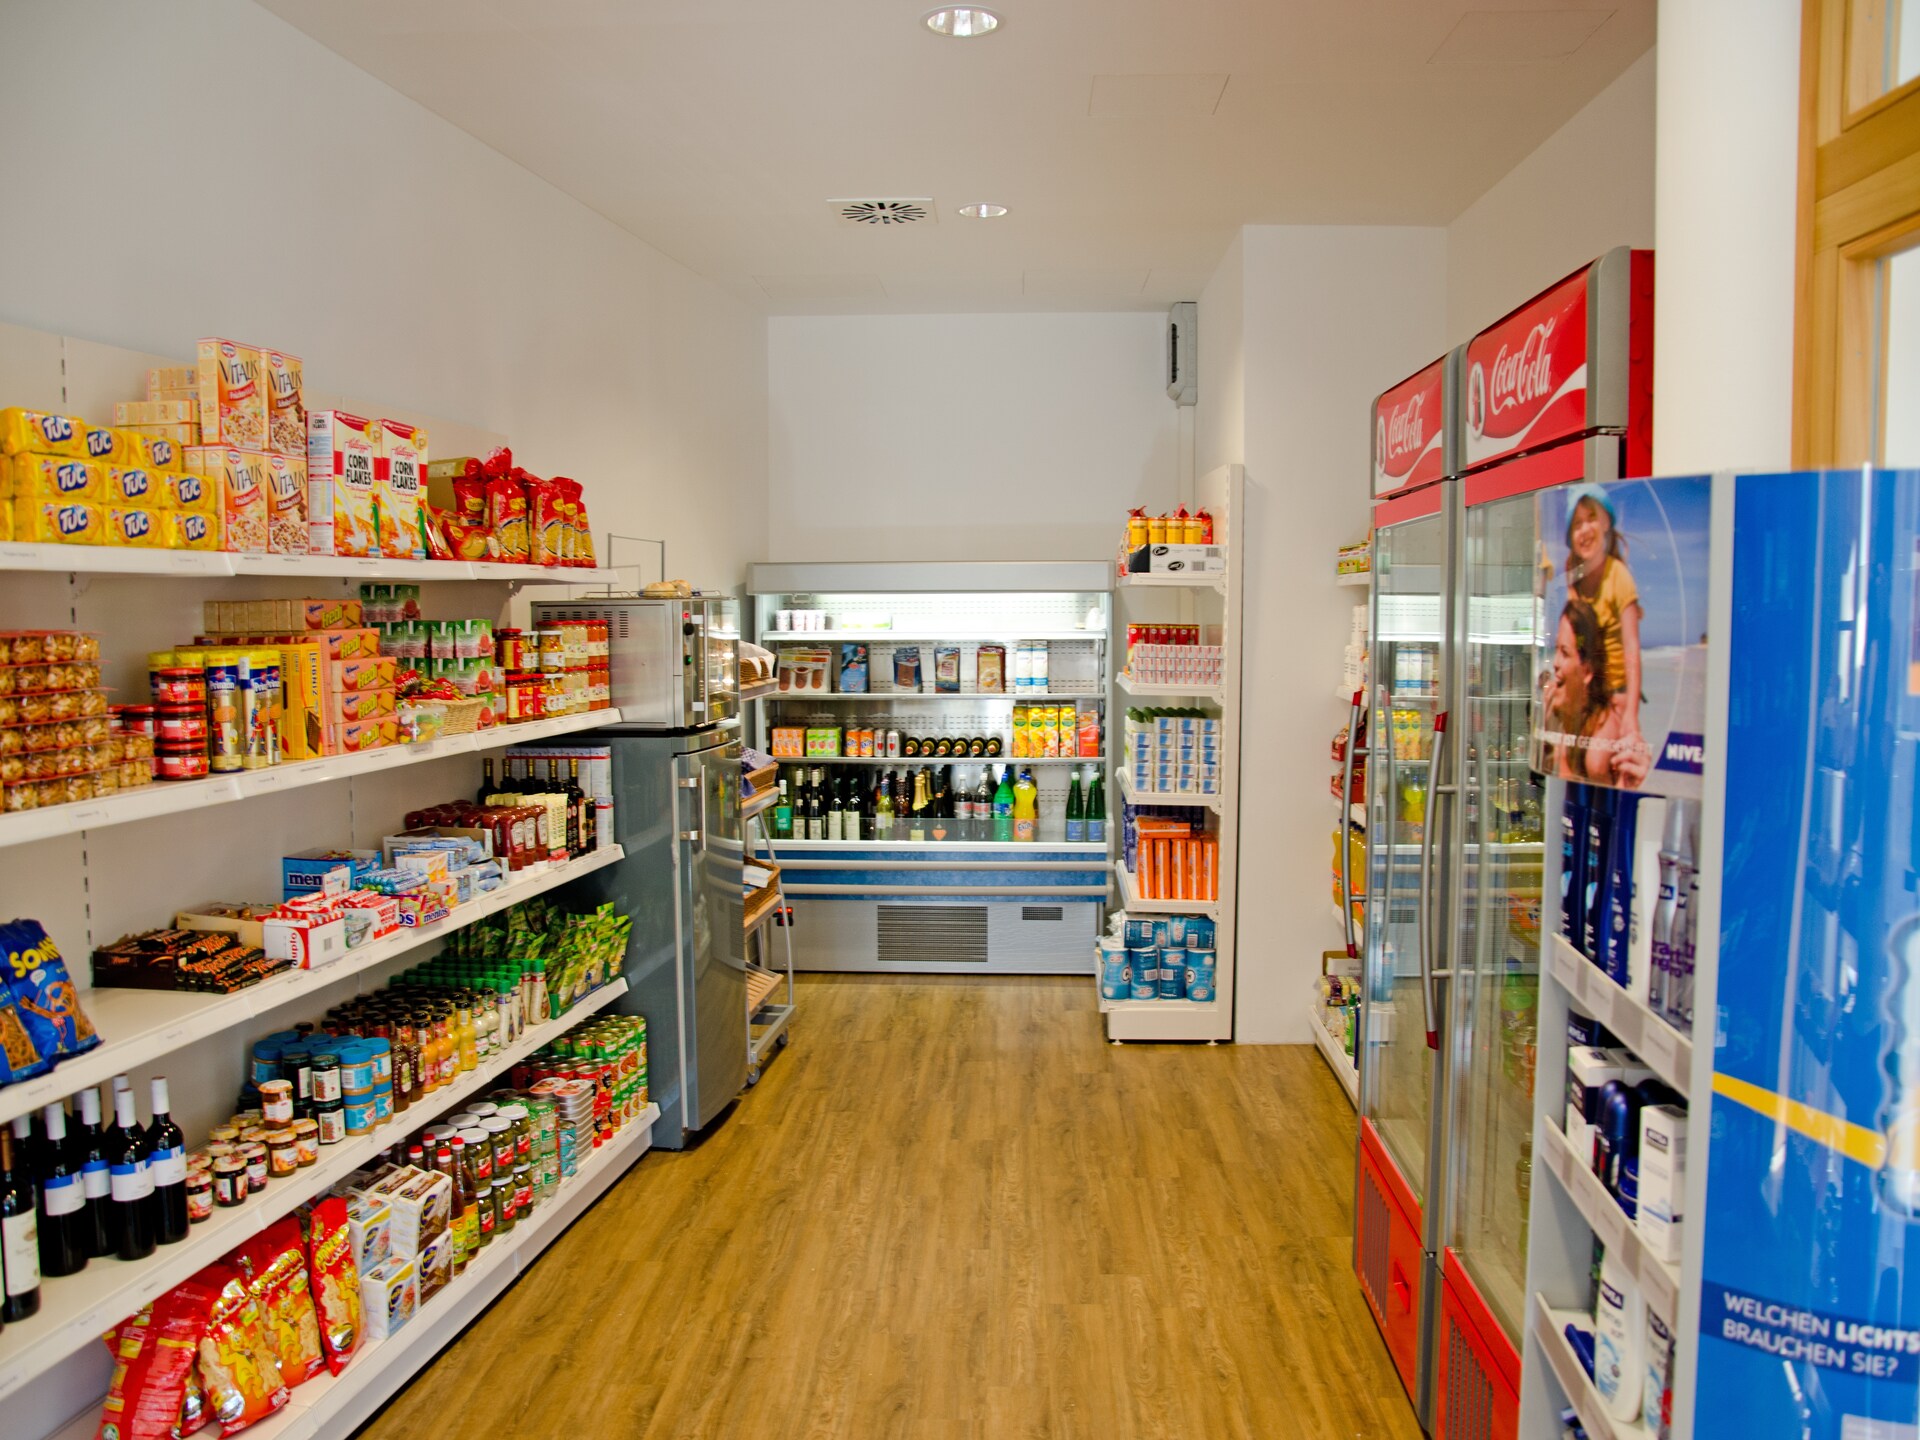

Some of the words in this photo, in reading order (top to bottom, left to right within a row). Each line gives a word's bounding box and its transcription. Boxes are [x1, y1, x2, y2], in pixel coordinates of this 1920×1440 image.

[43, 416, 72, 442] TUC
[88, 430, 113, 456] TUC
[153, 441, 172, 466] TUC
[348, 454, 369, 470] CORN
[394, 460, 415, 476] CORN
[57, 462, 88, 492] TUC
[123, 469, 148, 498] TUC
[346, 468, 372, 486] FLAKES
[392, 474, 418, 491] FLAKES
[179, 477, 201, 504] TUC
[59, 505, 89, 534] TUC
[124, 511, 149, 538] TUC
[186, 515, 206, 541] TUC
[309, 652, 319, 696] LEIBNIZ
[288, 873, 322, 887] men
[423, 907, 449, 923] mentos
[1723, 1291, 1830, 1338] WELCHEN
[1835, 1320, 1920, 1354] LICHTS
[1722, 1317, 1846, 1369] BRAUCHEN
[1852, 1351, 1899, 1378] SIE?
